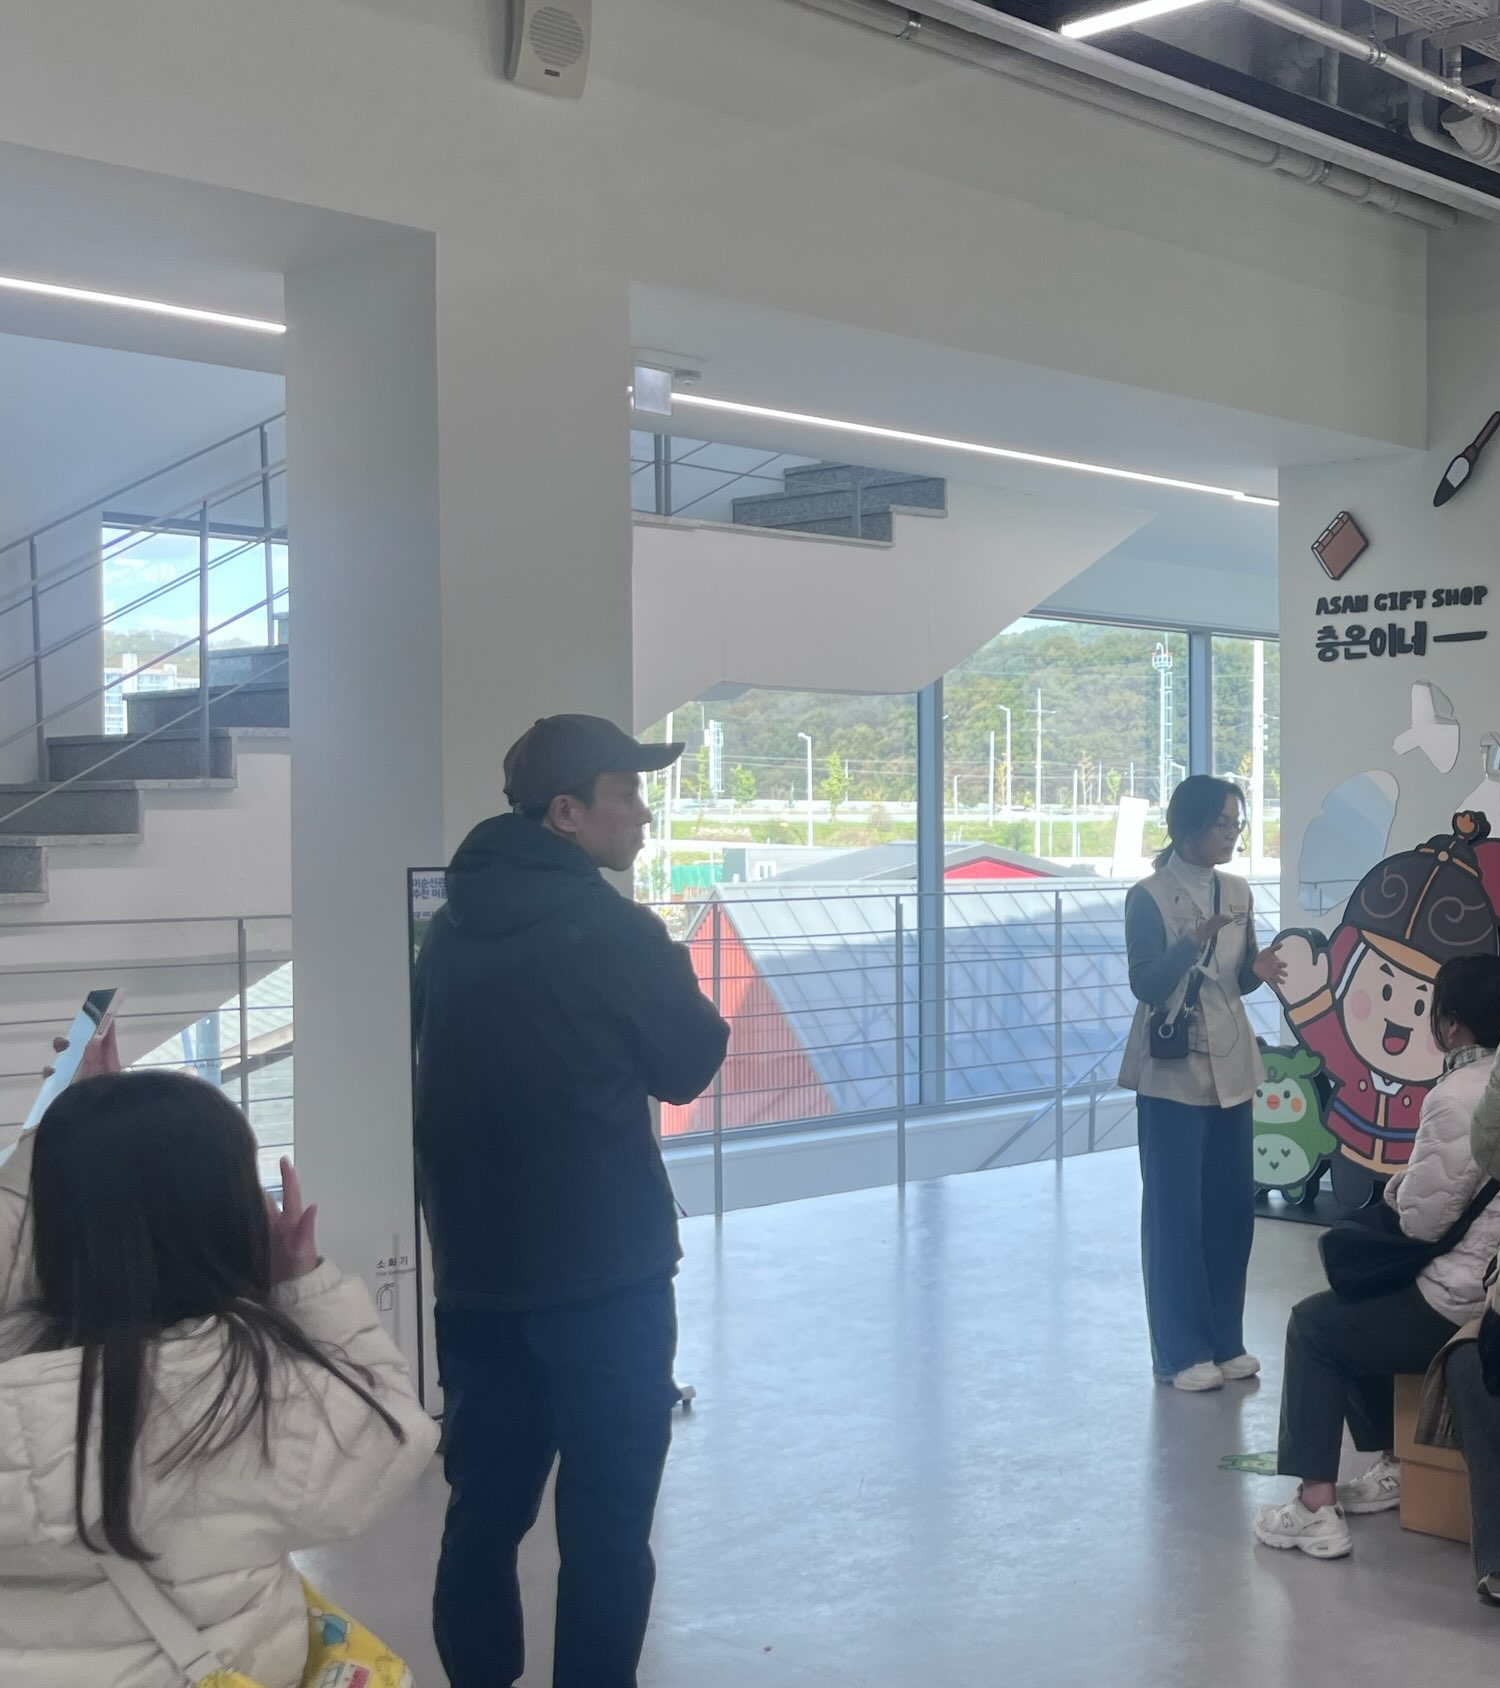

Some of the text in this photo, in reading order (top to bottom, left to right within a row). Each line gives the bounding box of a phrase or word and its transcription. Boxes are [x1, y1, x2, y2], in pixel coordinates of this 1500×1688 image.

[1315, 585, 1488, 616] ASAN GIFT SHOP
[1316, 621, 1427, 662] 충온이네
[377, 1256, 408, 1269] 소화기
